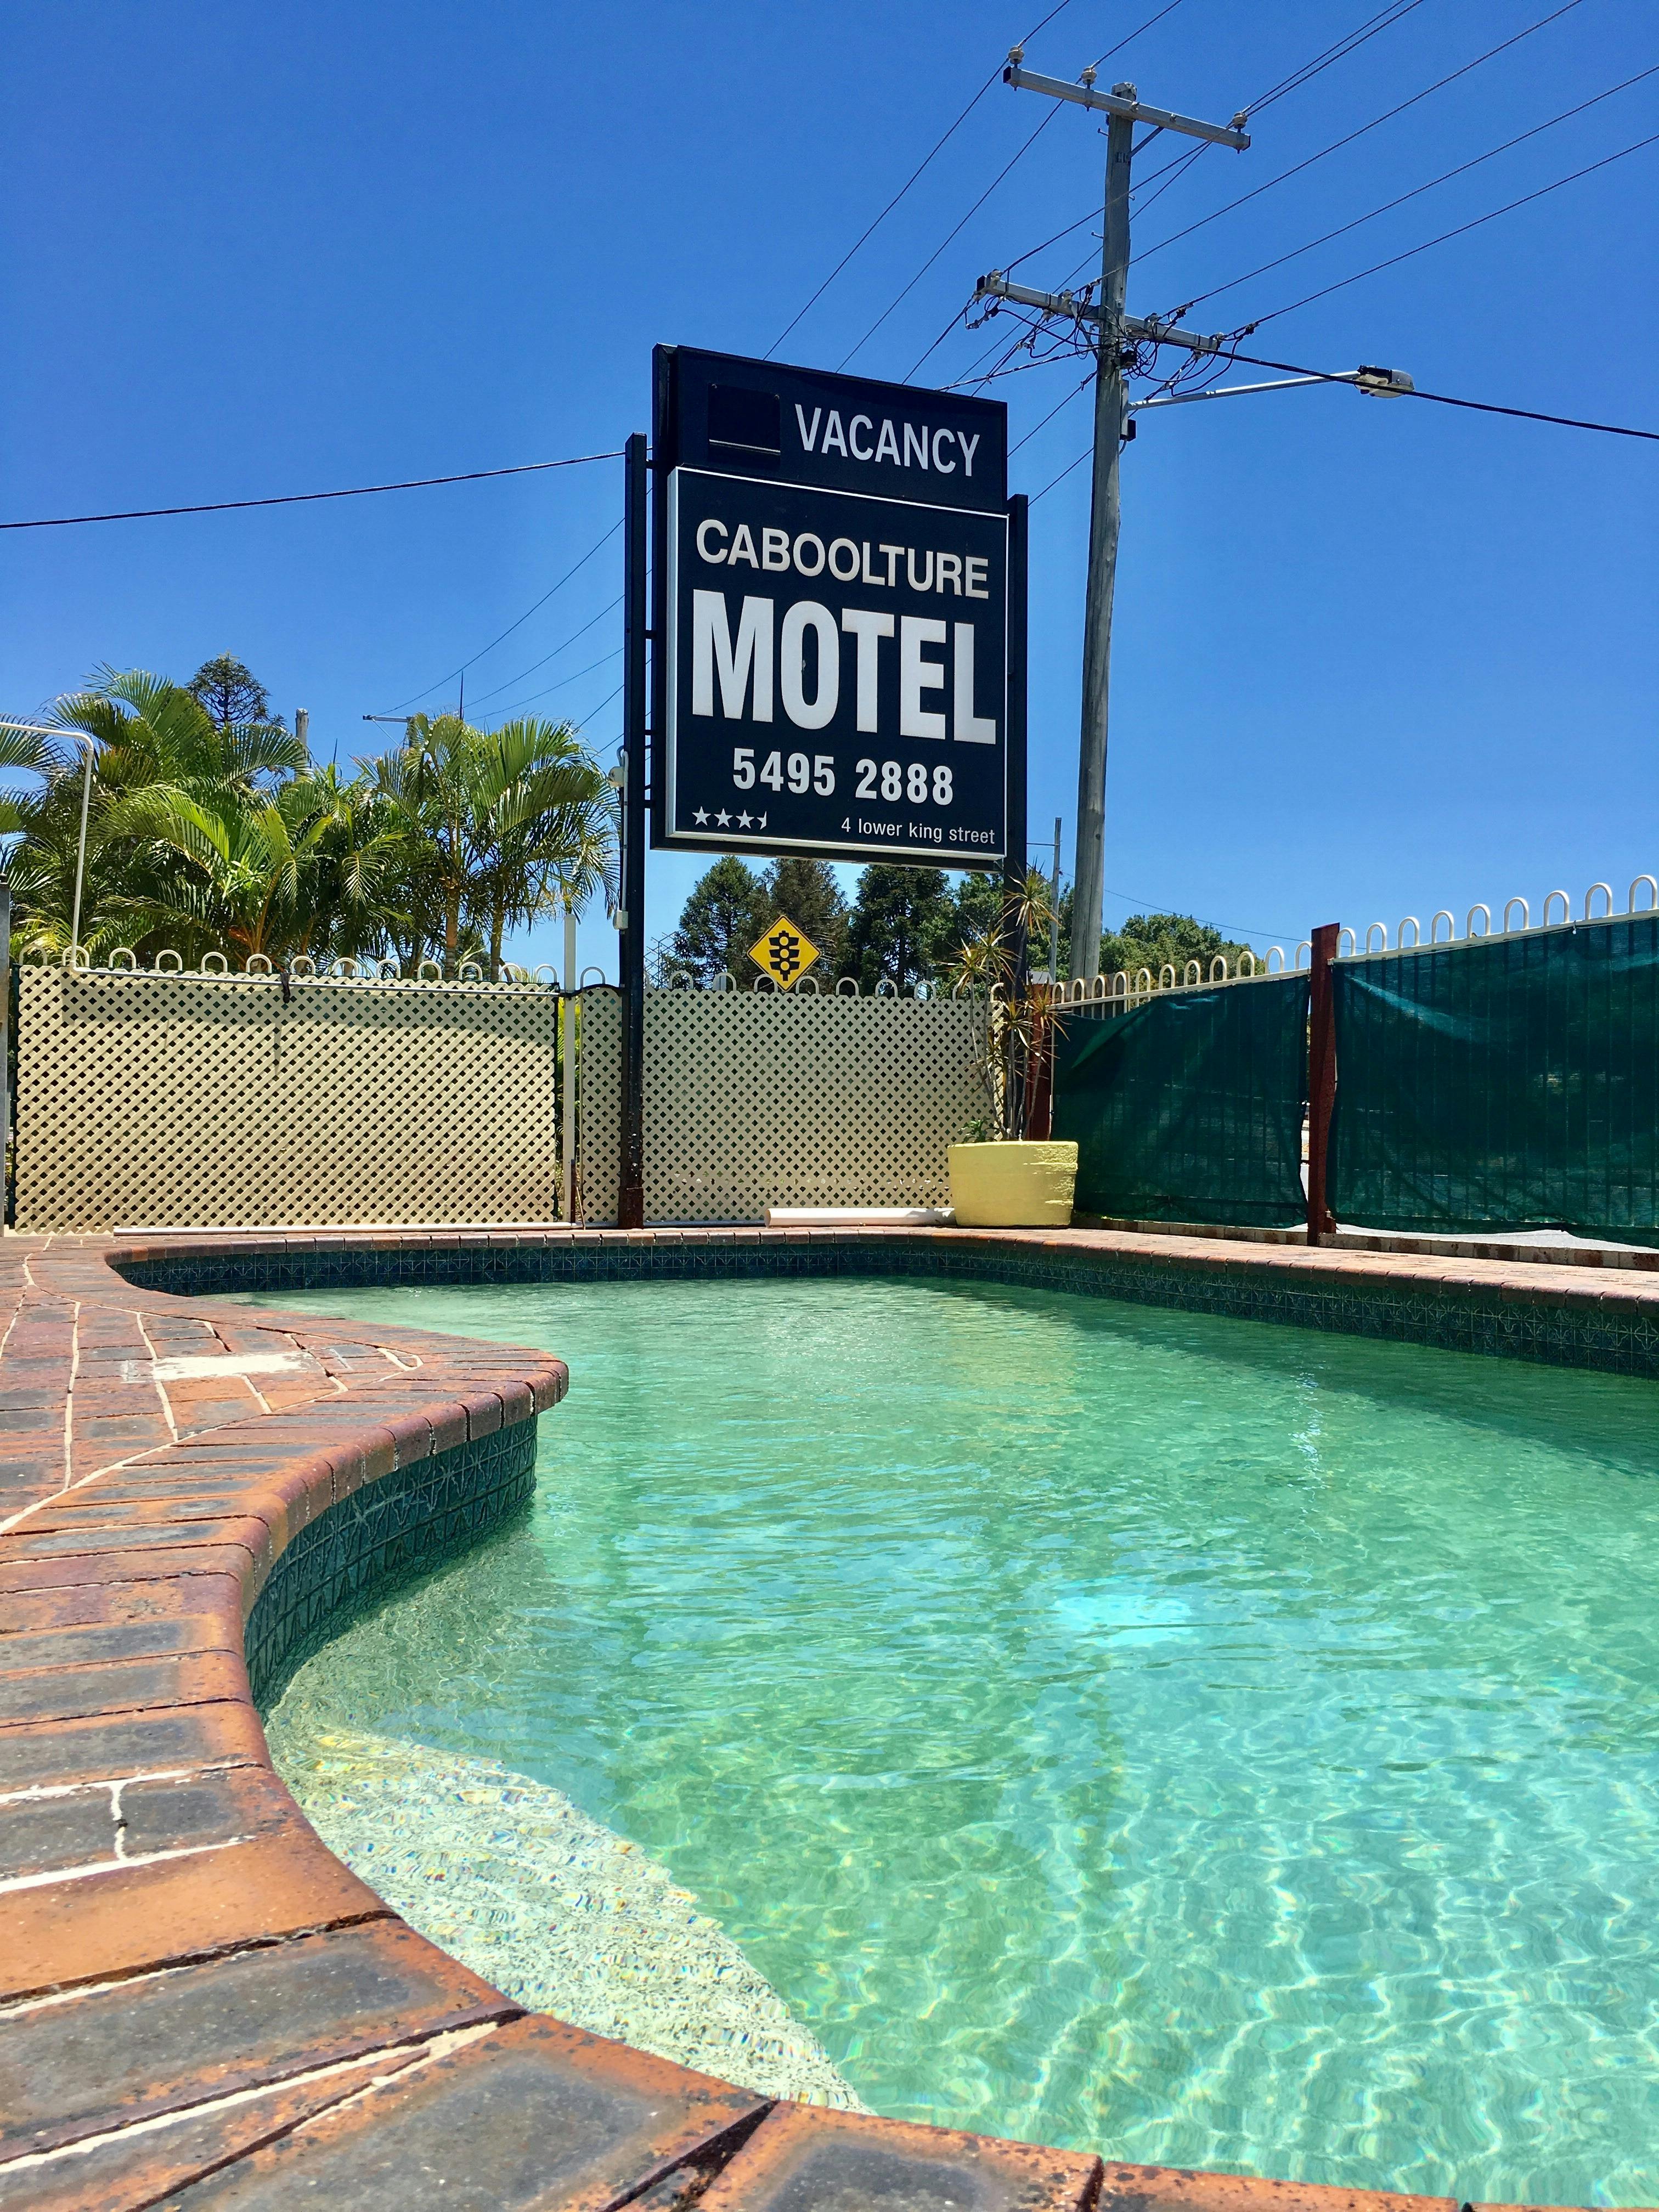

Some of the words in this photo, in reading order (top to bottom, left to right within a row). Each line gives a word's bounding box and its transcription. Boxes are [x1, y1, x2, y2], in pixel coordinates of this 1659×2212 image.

[795, 404, 979, 476] VACANCY
[696, 519, 989, 599] CABOOLTURE
[692, 589, 996, 744] MOTEL
[733, 748, 834, 795] 5495
[856, 759, 952, 805] 2888
[842, 817, 850, 832] 4
[859, 819, 902, 836] lower
[910, 823, 941, 843] king
[950, 827, 994, 844] street
